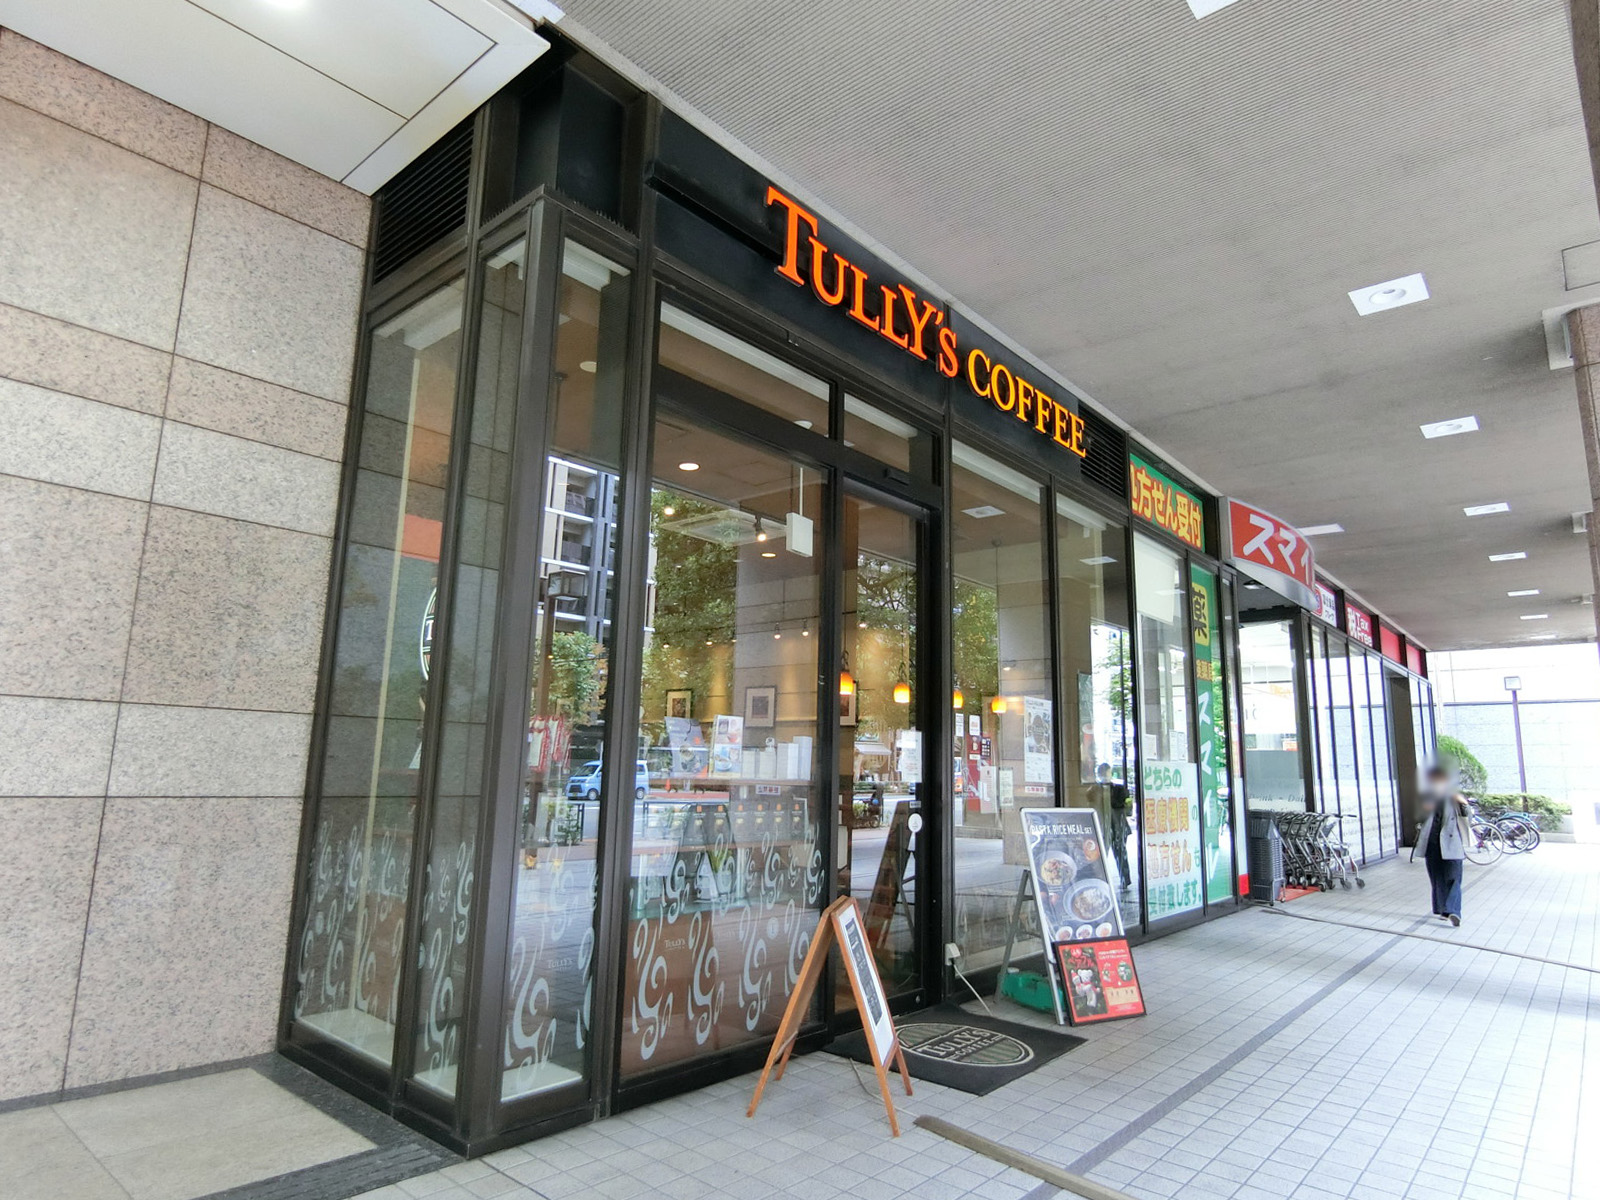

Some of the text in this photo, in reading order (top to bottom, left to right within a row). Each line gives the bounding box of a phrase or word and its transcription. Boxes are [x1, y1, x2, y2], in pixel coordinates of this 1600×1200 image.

[766, 185, 1087, 458] TULLY'S COFFEE
[1144, 765, 1182, 791] どちらの
[916, 1029, 991, 1056] TULLY'S
